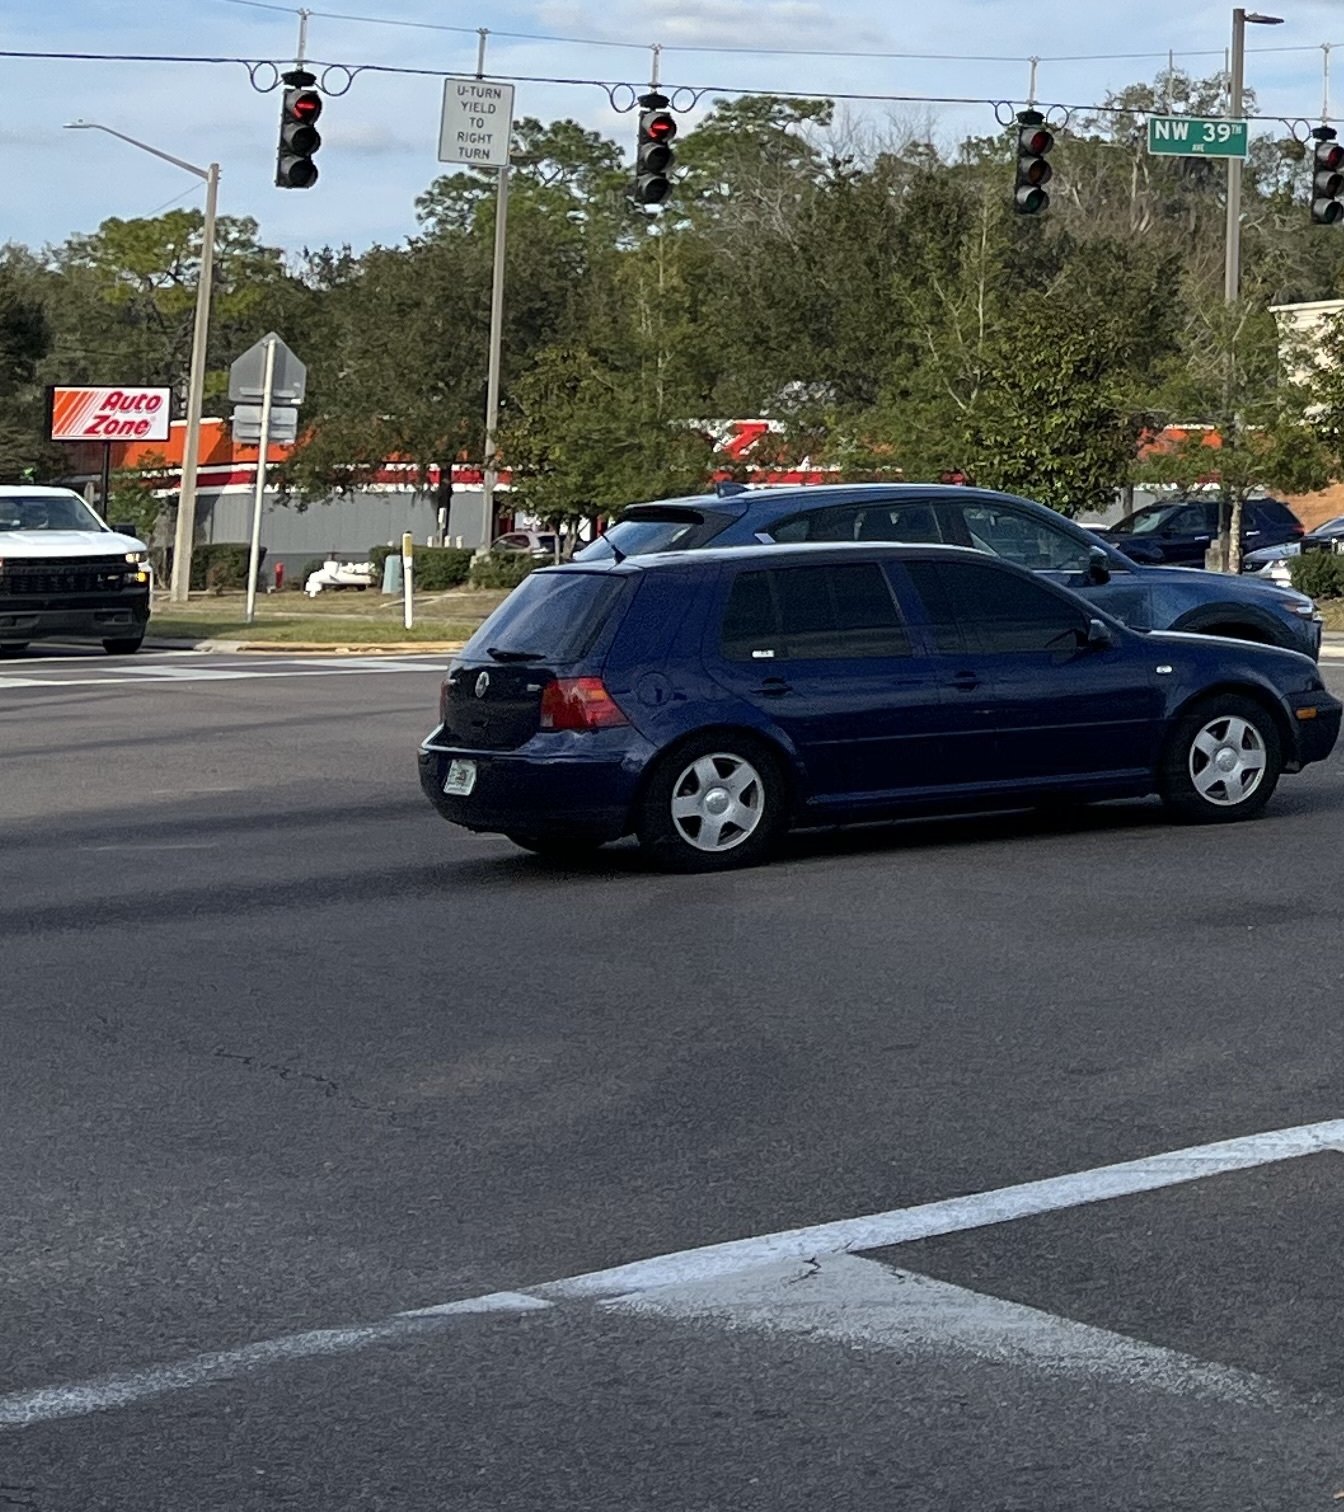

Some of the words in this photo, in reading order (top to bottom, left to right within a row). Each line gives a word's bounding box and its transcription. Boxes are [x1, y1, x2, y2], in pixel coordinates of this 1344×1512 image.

[457, 85, 502, 99] U-TURN
[461, 101, 497, 114] YIELD
[469, 117, 484, 129] TO
[1154, 120, 1189, 140] NW
[457, 131, 493, 144] RIGHT
[458, 146, 491, 160] TURN
[98, 390, 163, 412] Auto
[82, 414, 151, 436] Zone
